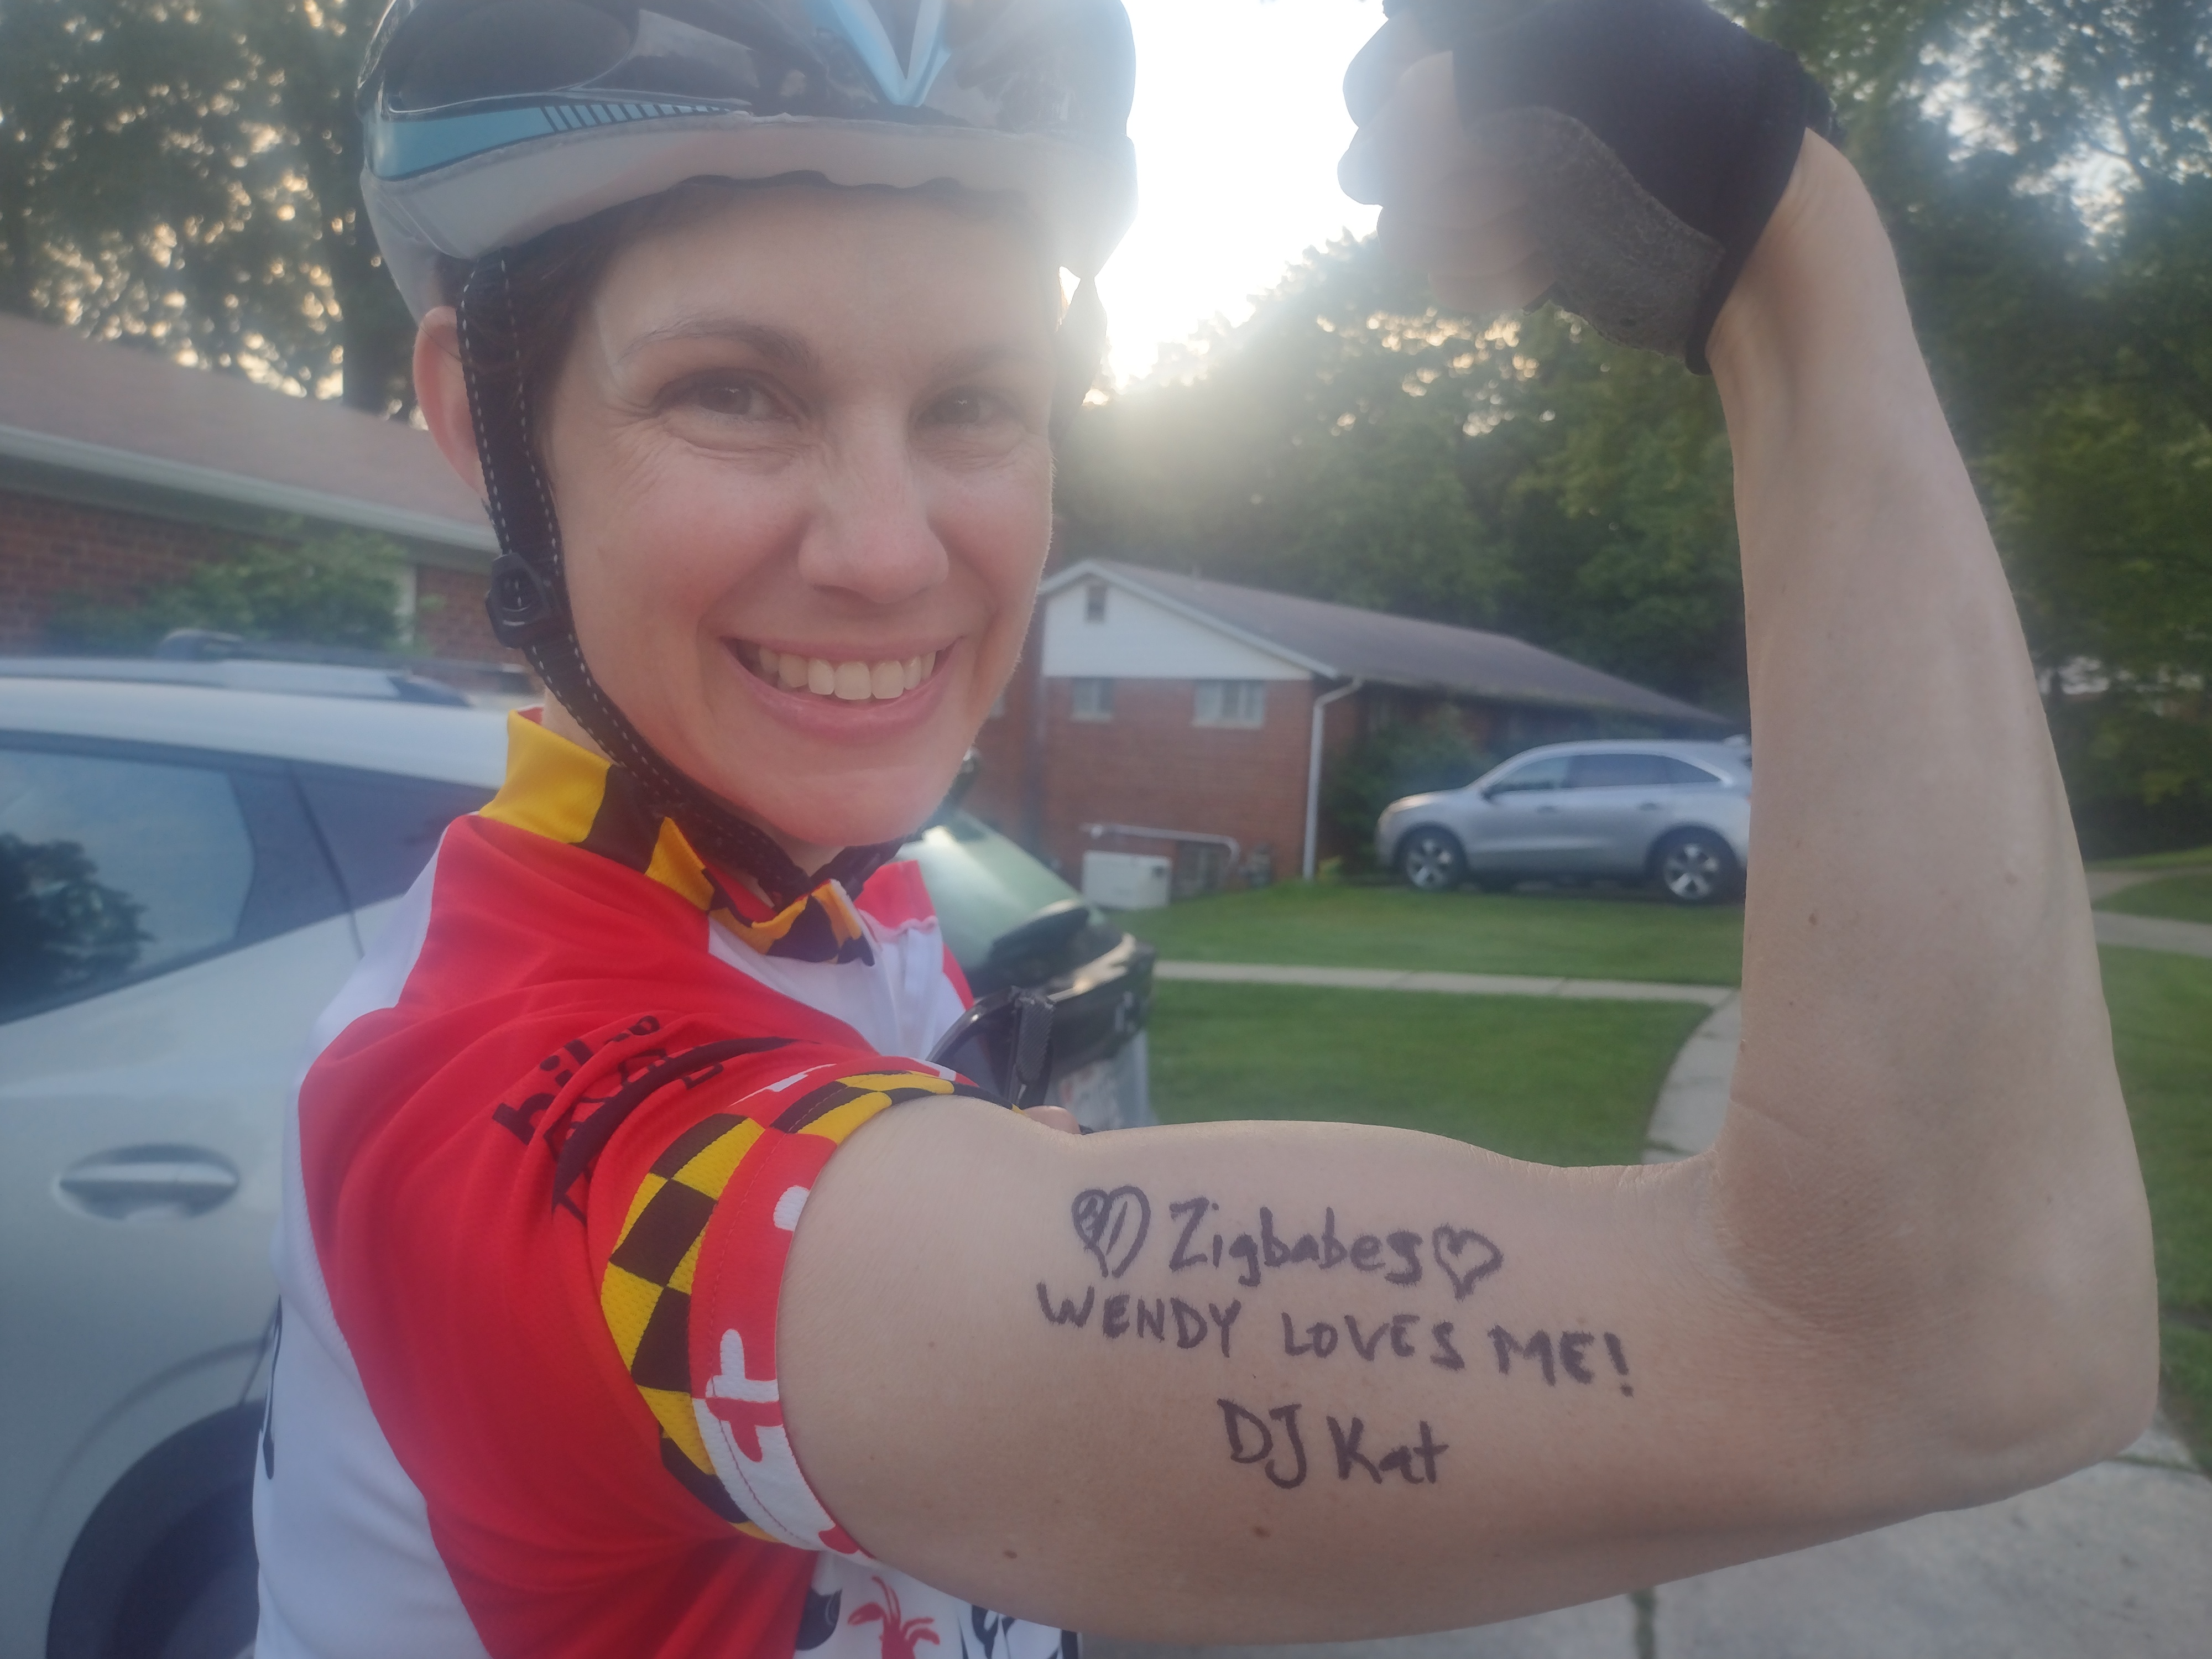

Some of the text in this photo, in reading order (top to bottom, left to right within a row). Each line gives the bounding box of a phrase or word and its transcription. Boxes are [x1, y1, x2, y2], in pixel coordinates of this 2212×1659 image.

[1037, 1282, 1634, 1397] WENDY LOVES ME!
[1217, 1399, 1449, 1489] DJ Kat
